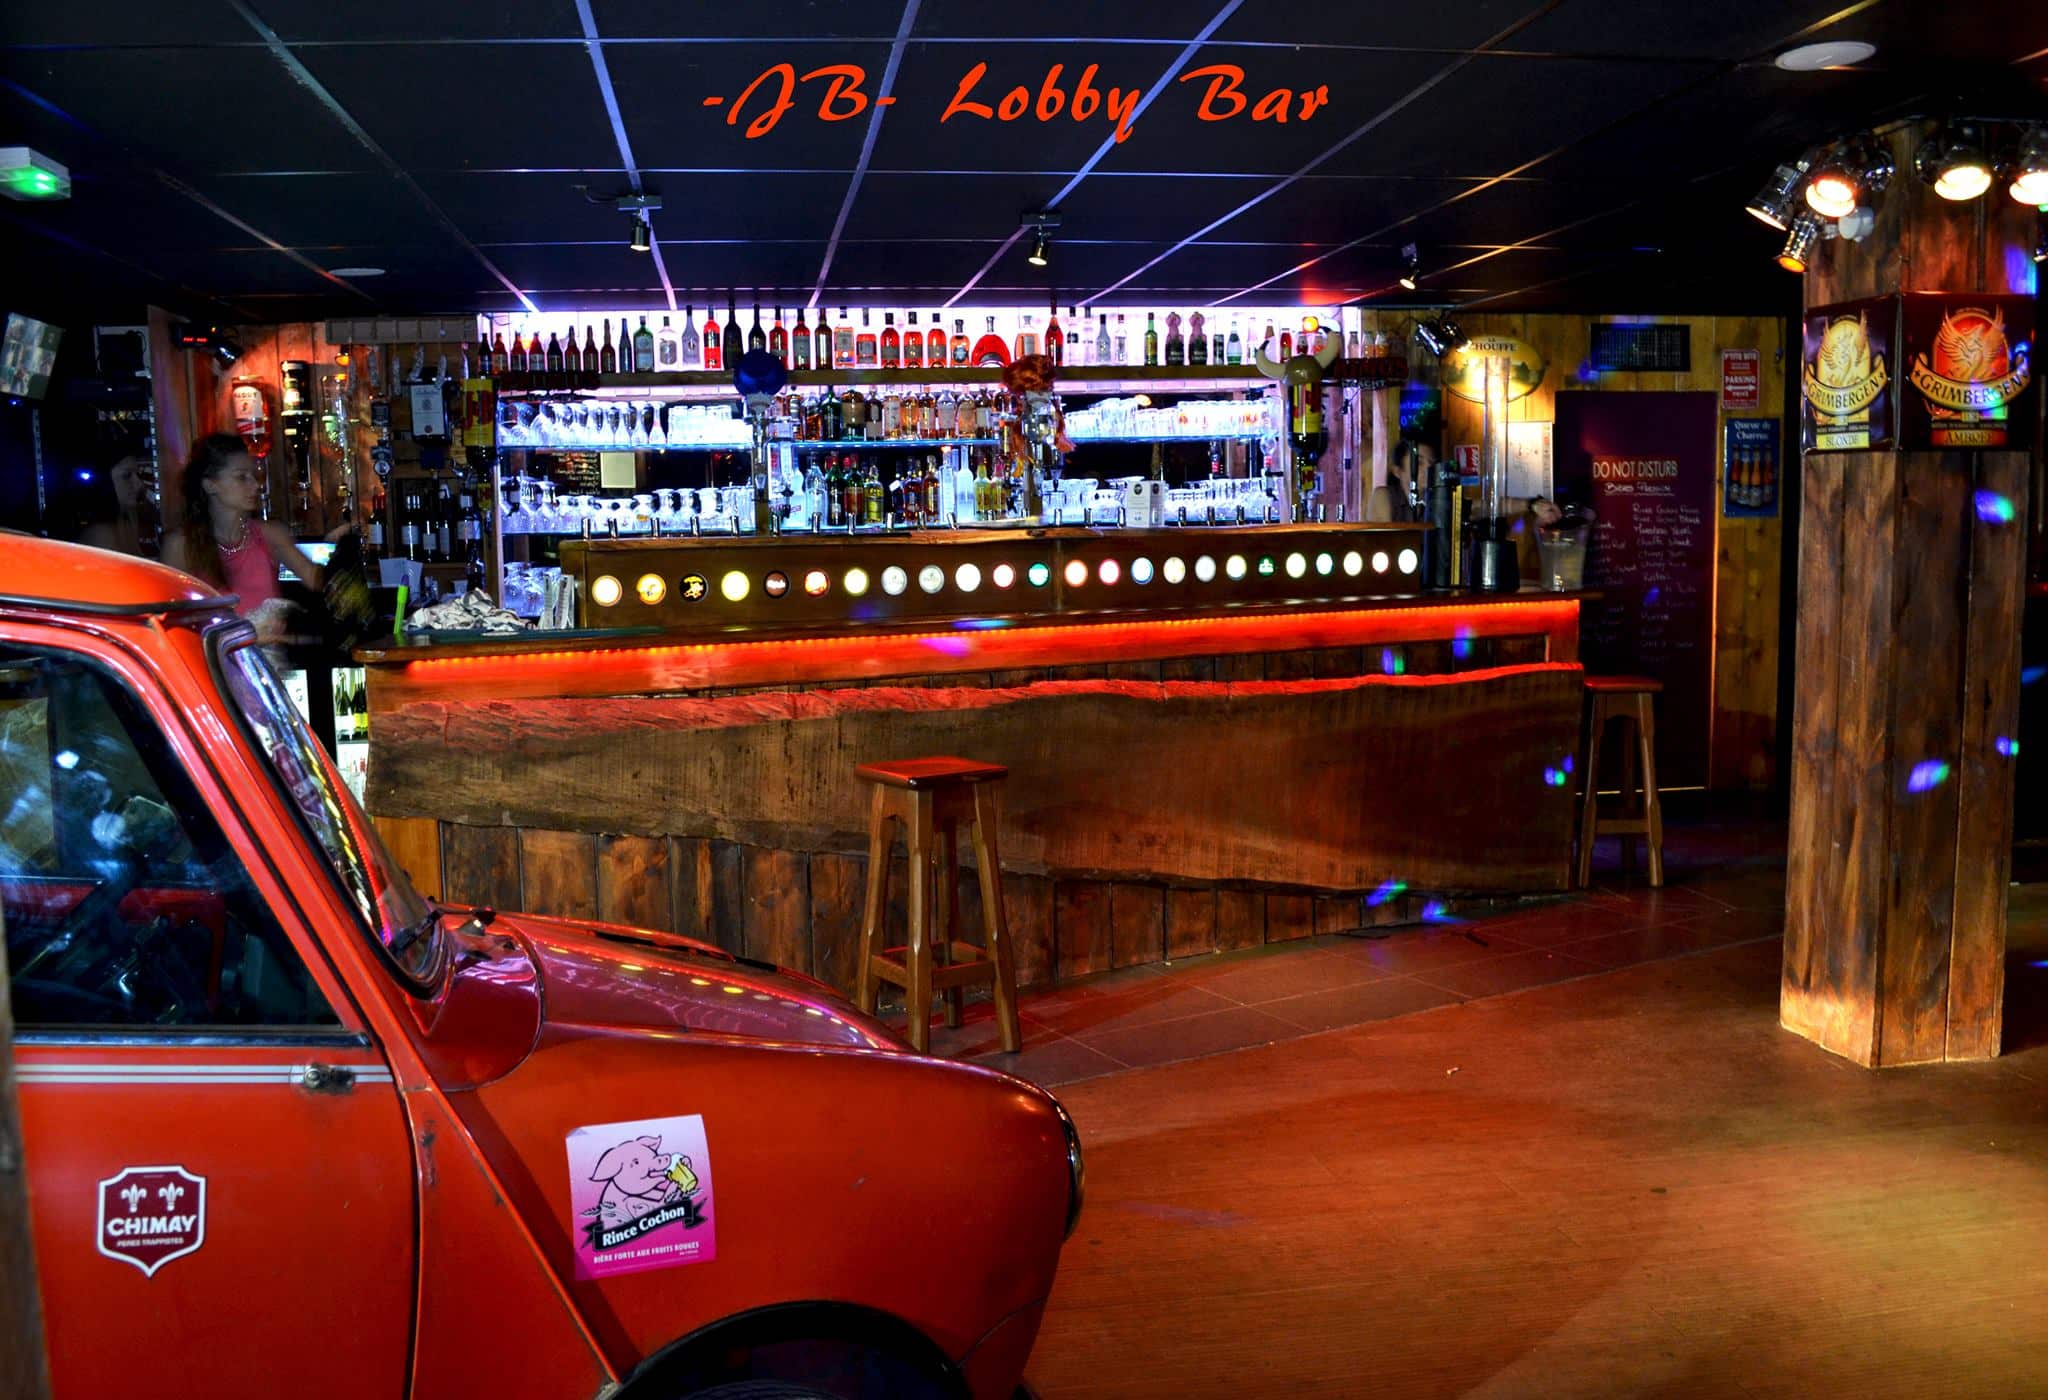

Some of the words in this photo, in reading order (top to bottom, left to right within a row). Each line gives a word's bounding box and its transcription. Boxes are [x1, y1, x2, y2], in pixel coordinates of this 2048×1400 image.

[1725, 376, 1757, 384] PARKING
[1920, 367, 2027, 405] GRIMBERGEN
[1809, 377, 1878, 408] GRIMBERGEN
[1593, 461, 1609, 478] DO
[1612, 461, 1635, 477] NOT
[1638, 460, 1678, 477] DISTURB
[107, 1215, 197, 1236] CHIMAY
[602, 1227, 638, 1247] Rince
[638, 1206, 685, 1233] Cochon
[614, 1250, 635, 1261] FORTE
[636, 1248, 651, 1257] AUX
[651, 1245, 674, 1256] FRUITS
[674, 1241, 700, 1252] ROUGES
